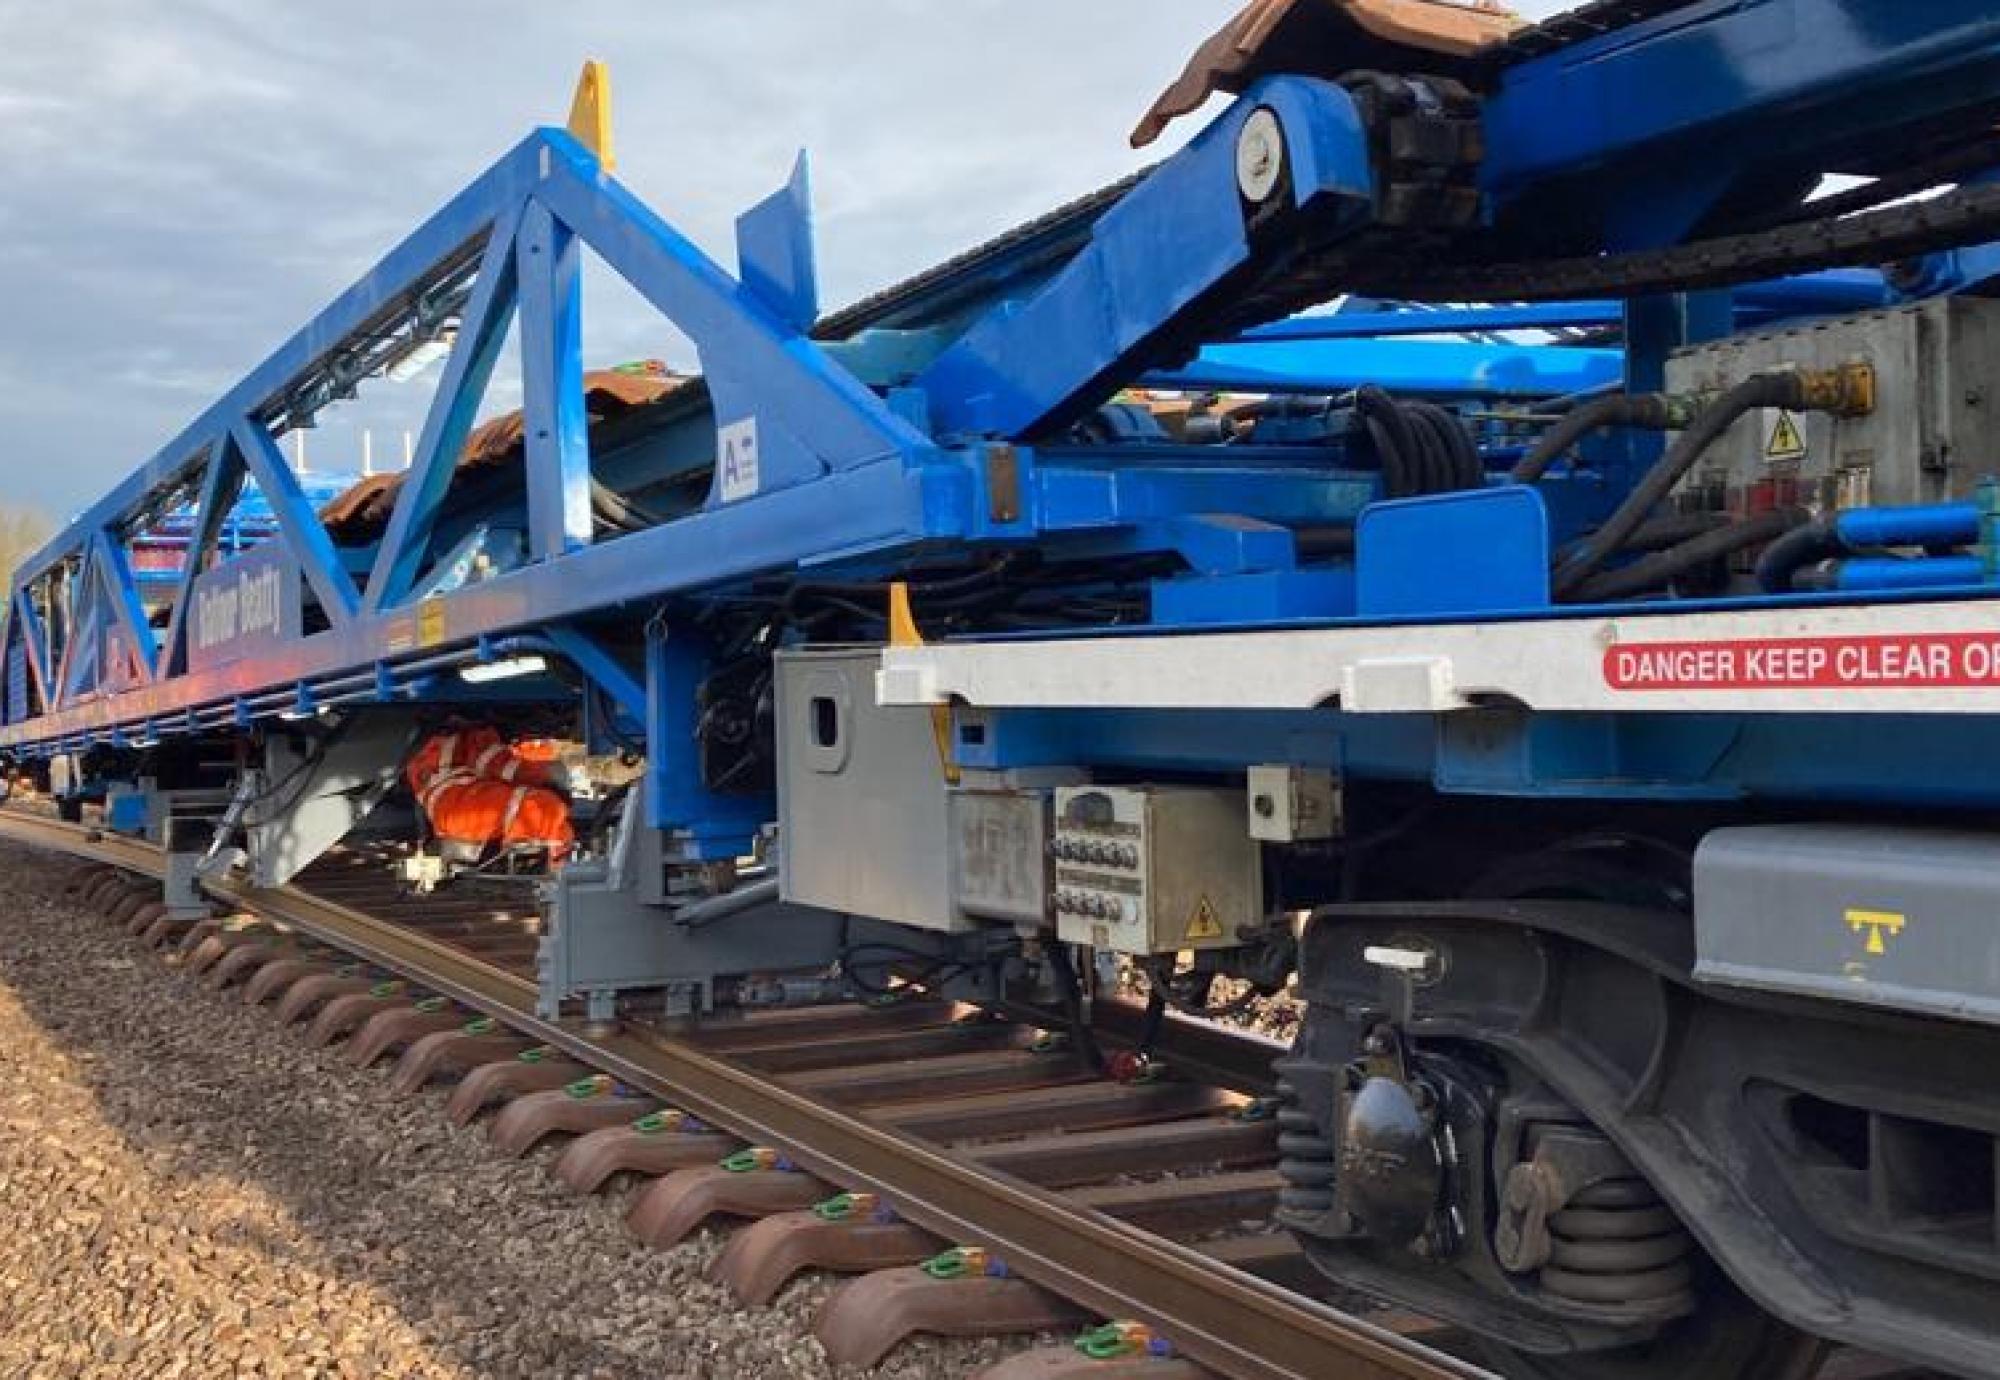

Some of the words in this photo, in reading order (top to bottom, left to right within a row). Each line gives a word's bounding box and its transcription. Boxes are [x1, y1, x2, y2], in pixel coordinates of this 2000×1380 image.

[1618, 651, 1735, 681] DANGER
[1744, 648, 1827, 680] KEEP
[1836, 644, 1951, 679] CLEAR
